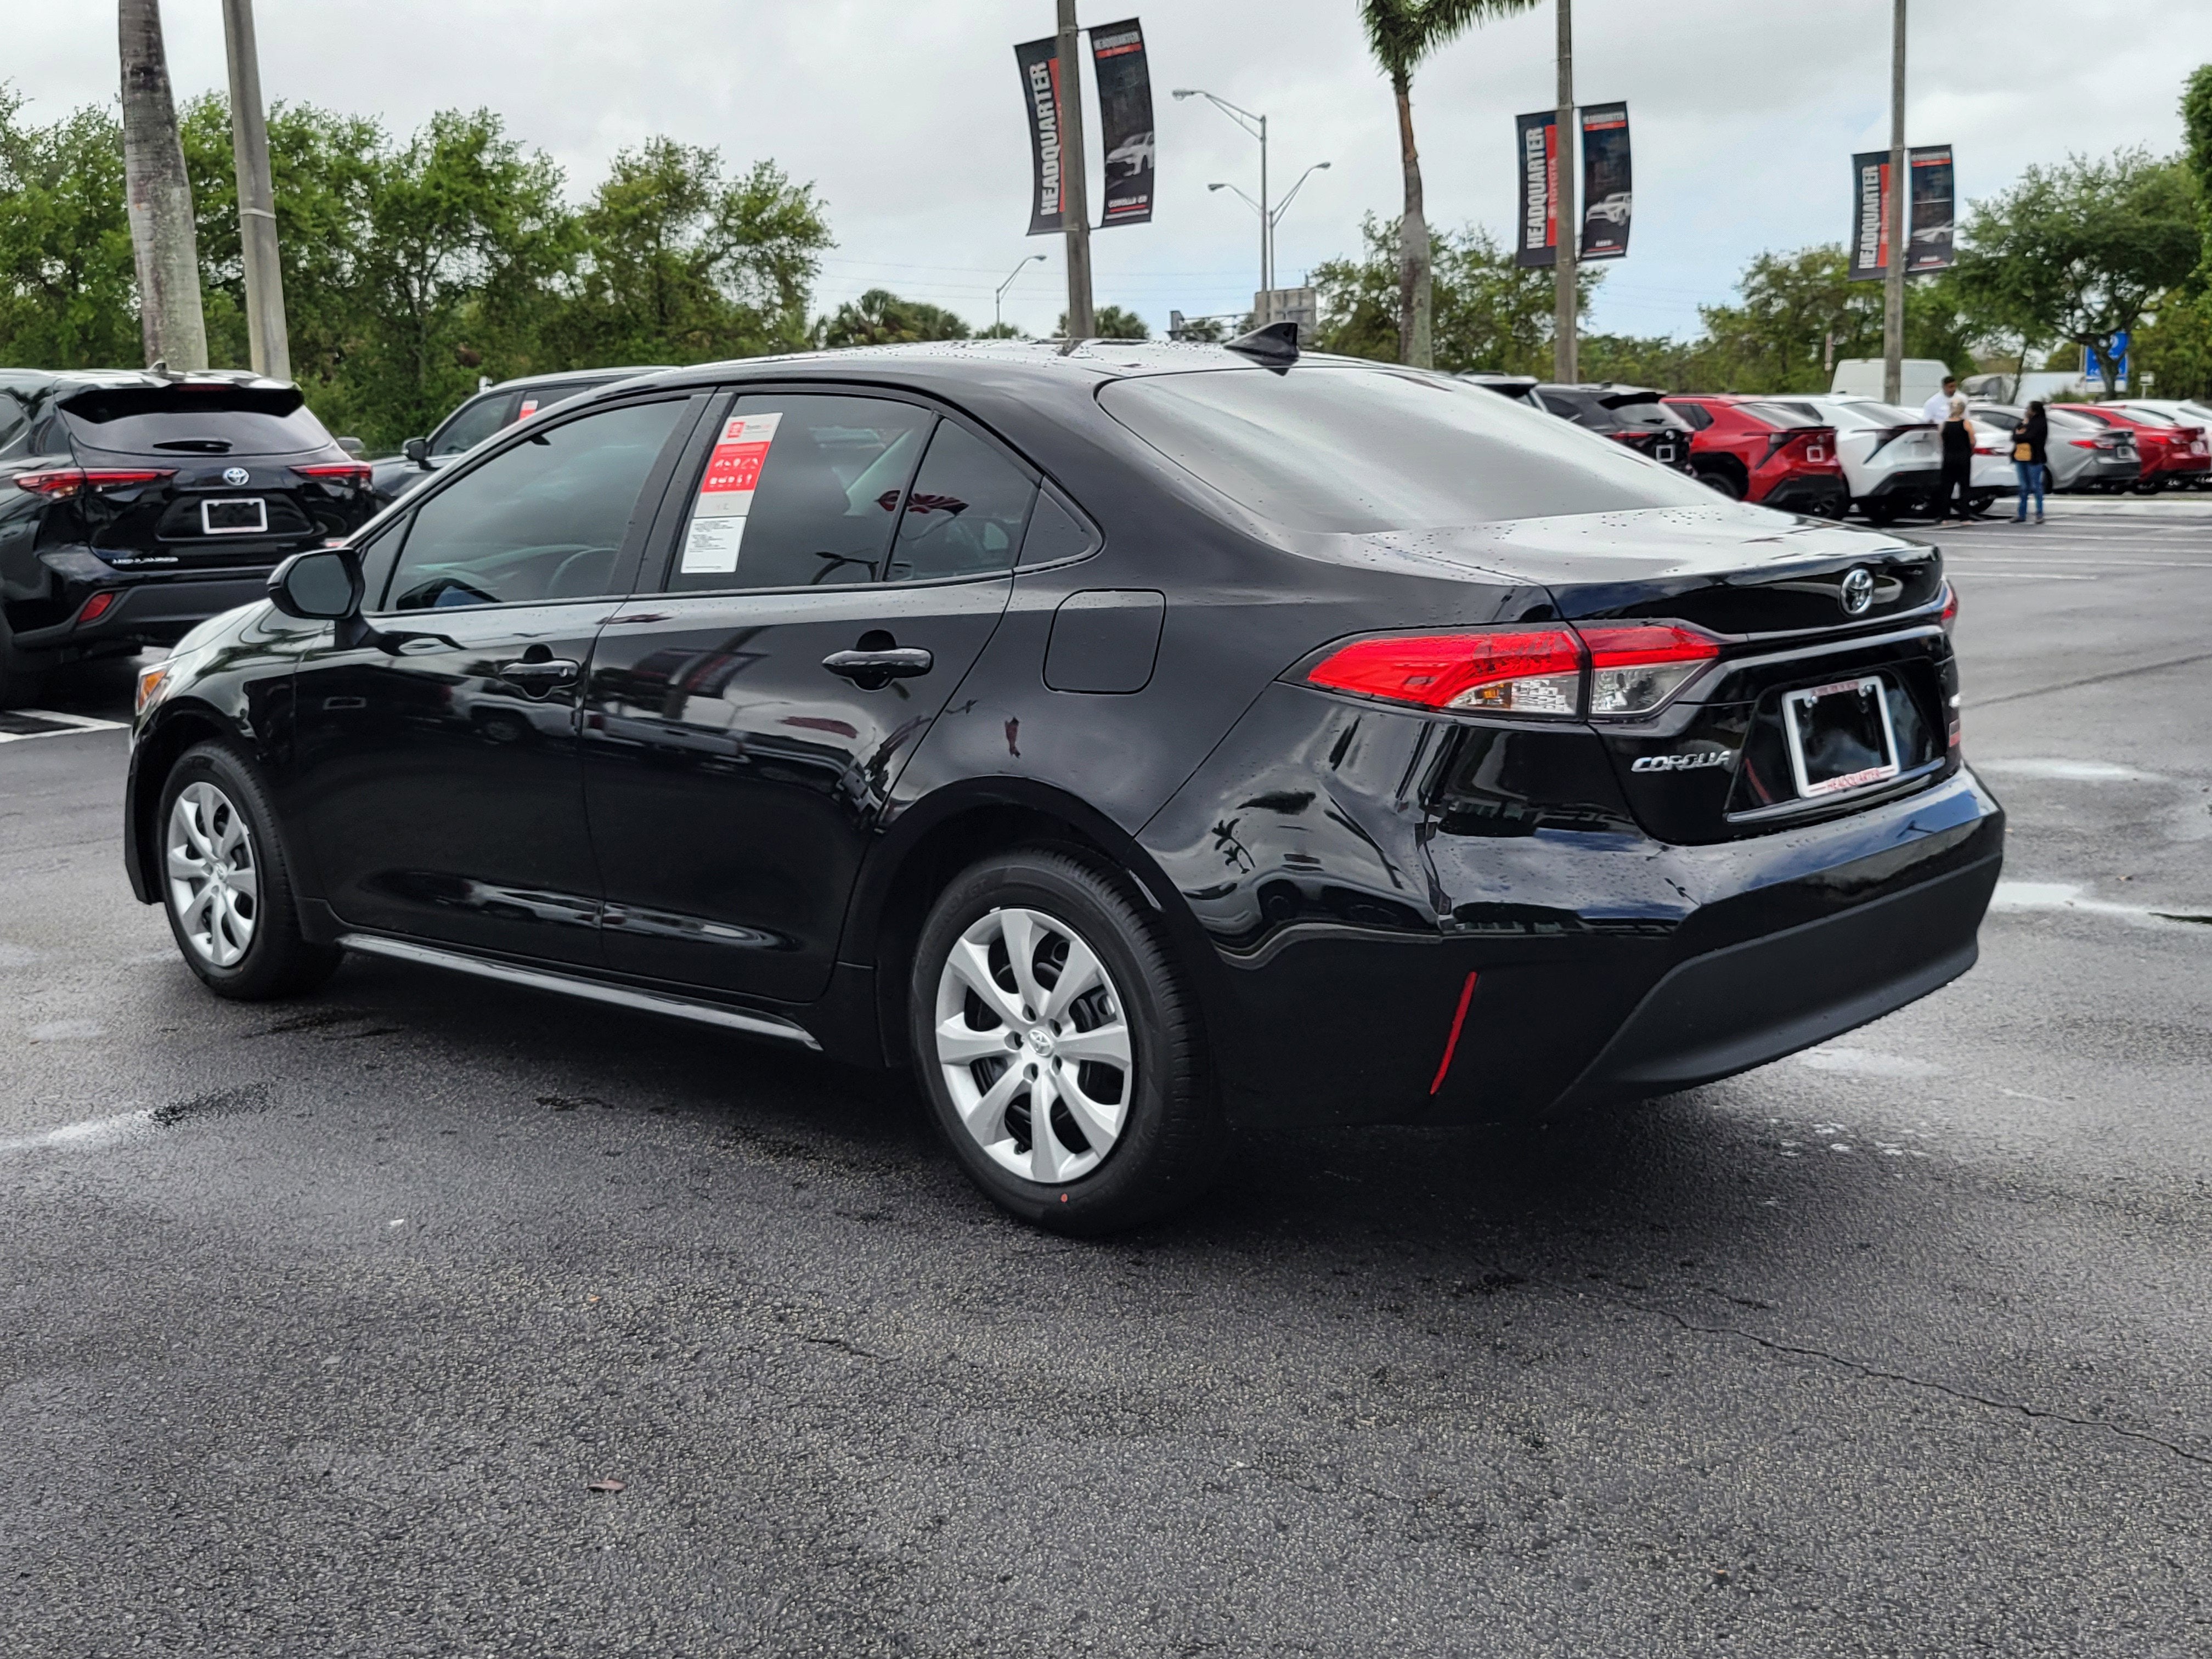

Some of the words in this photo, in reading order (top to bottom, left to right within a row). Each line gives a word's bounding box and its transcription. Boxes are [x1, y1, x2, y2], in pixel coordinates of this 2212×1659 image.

[1029, 60, 1061, 216] HEADQUARTER
[1526, 126, 1548, 250] HEADQUARTER
[1858, 165, 1880, 269] HEADQUARTER
[1631, 750, 1731, 772] COROLLA
